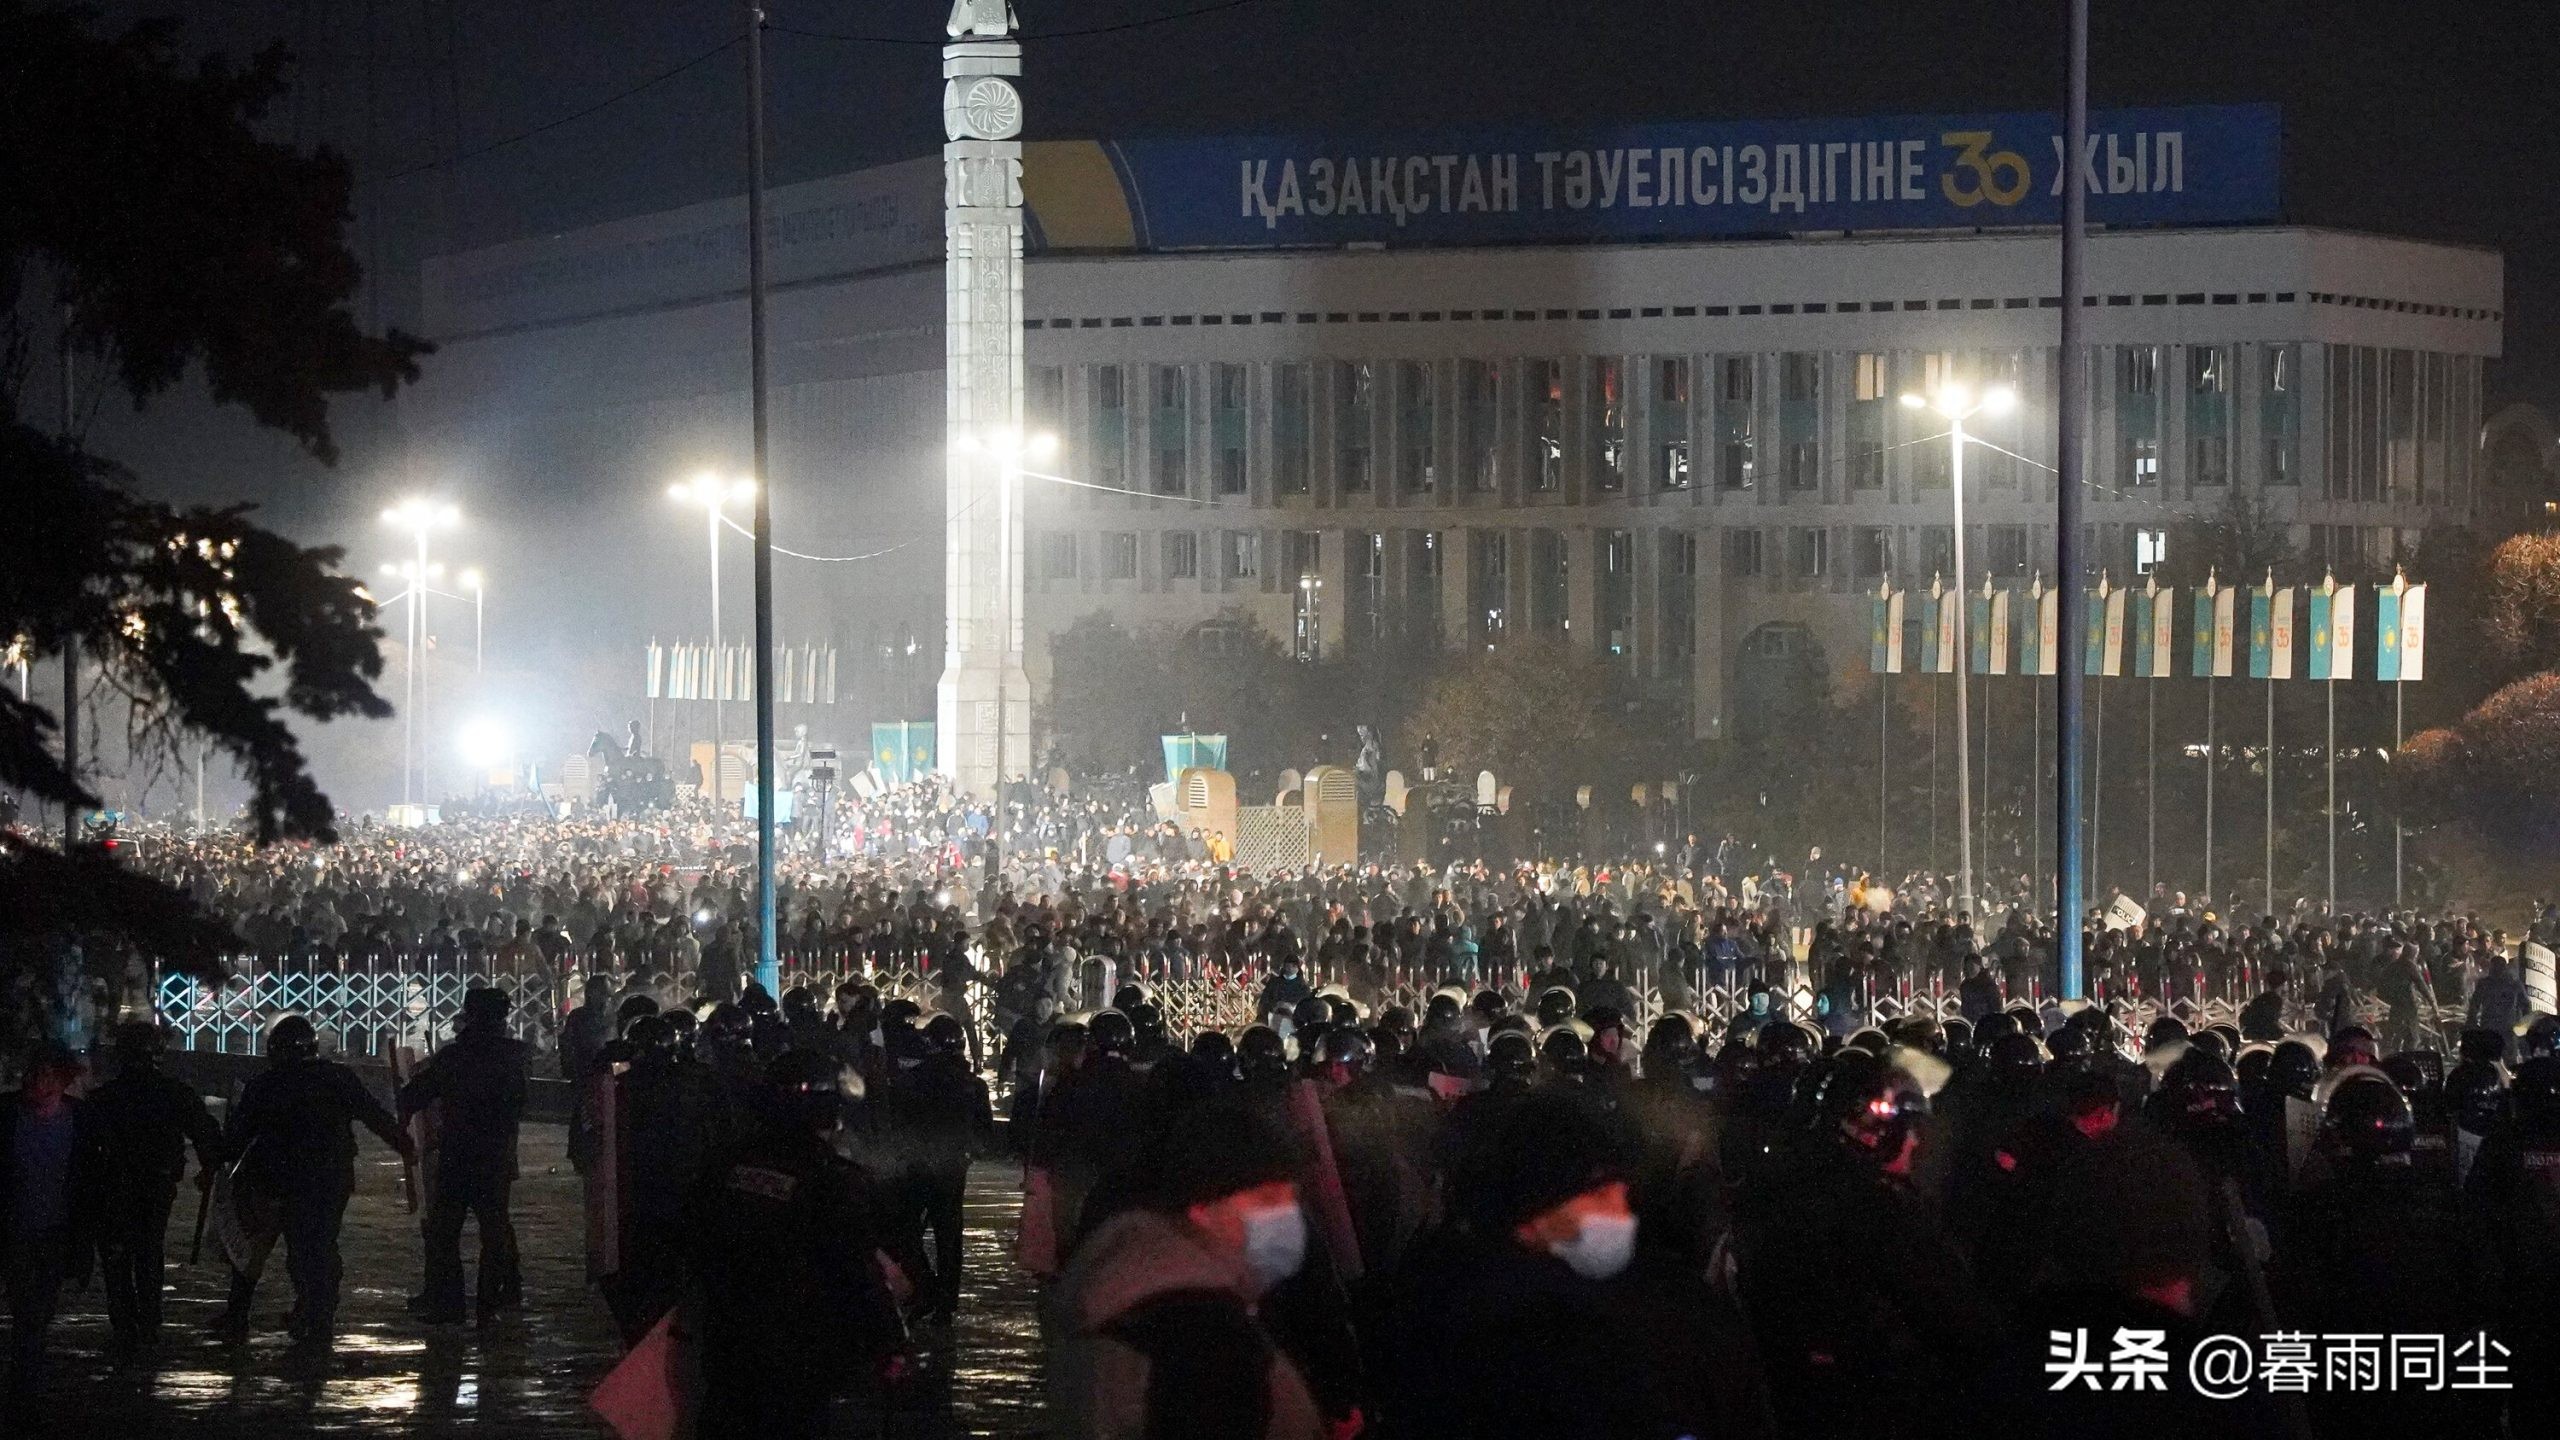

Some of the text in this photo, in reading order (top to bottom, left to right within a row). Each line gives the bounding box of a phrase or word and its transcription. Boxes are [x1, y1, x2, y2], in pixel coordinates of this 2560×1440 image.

[1241, 131, 2183, 229] ҚАЗАҚСТАН ТӘУЕЛСІЗДІГІНЕ 30 ЖЫЛ
